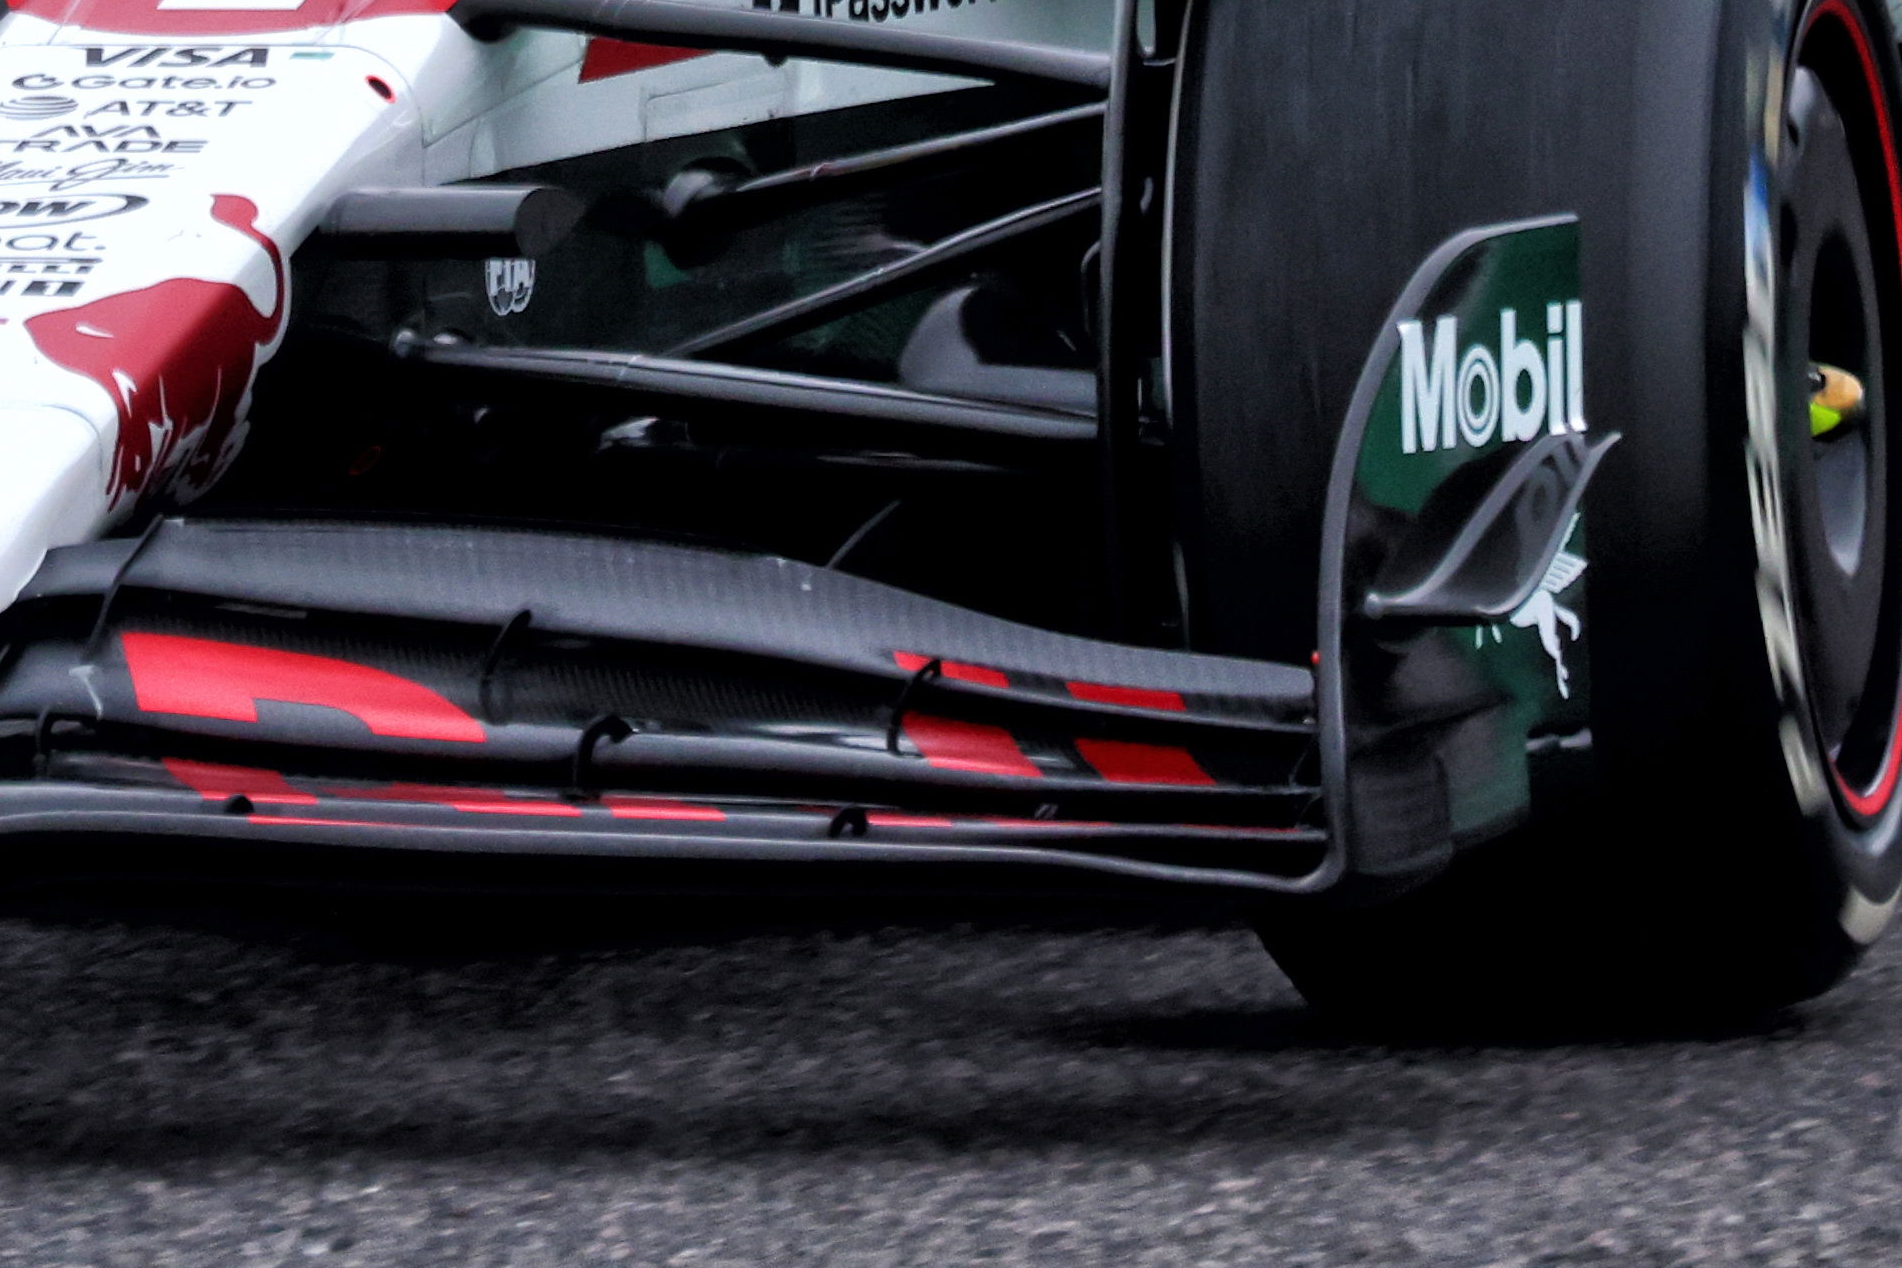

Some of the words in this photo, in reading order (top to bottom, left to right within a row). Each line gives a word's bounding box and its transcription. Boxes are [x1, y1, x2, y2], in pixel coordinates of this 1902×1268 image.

[85, 47, 269, 68] VISA
[70, 75, 277, 90] Gate.io
[83, 100, 253, 118] AT&T
[1397, 299, 1588, 454] Mobil
